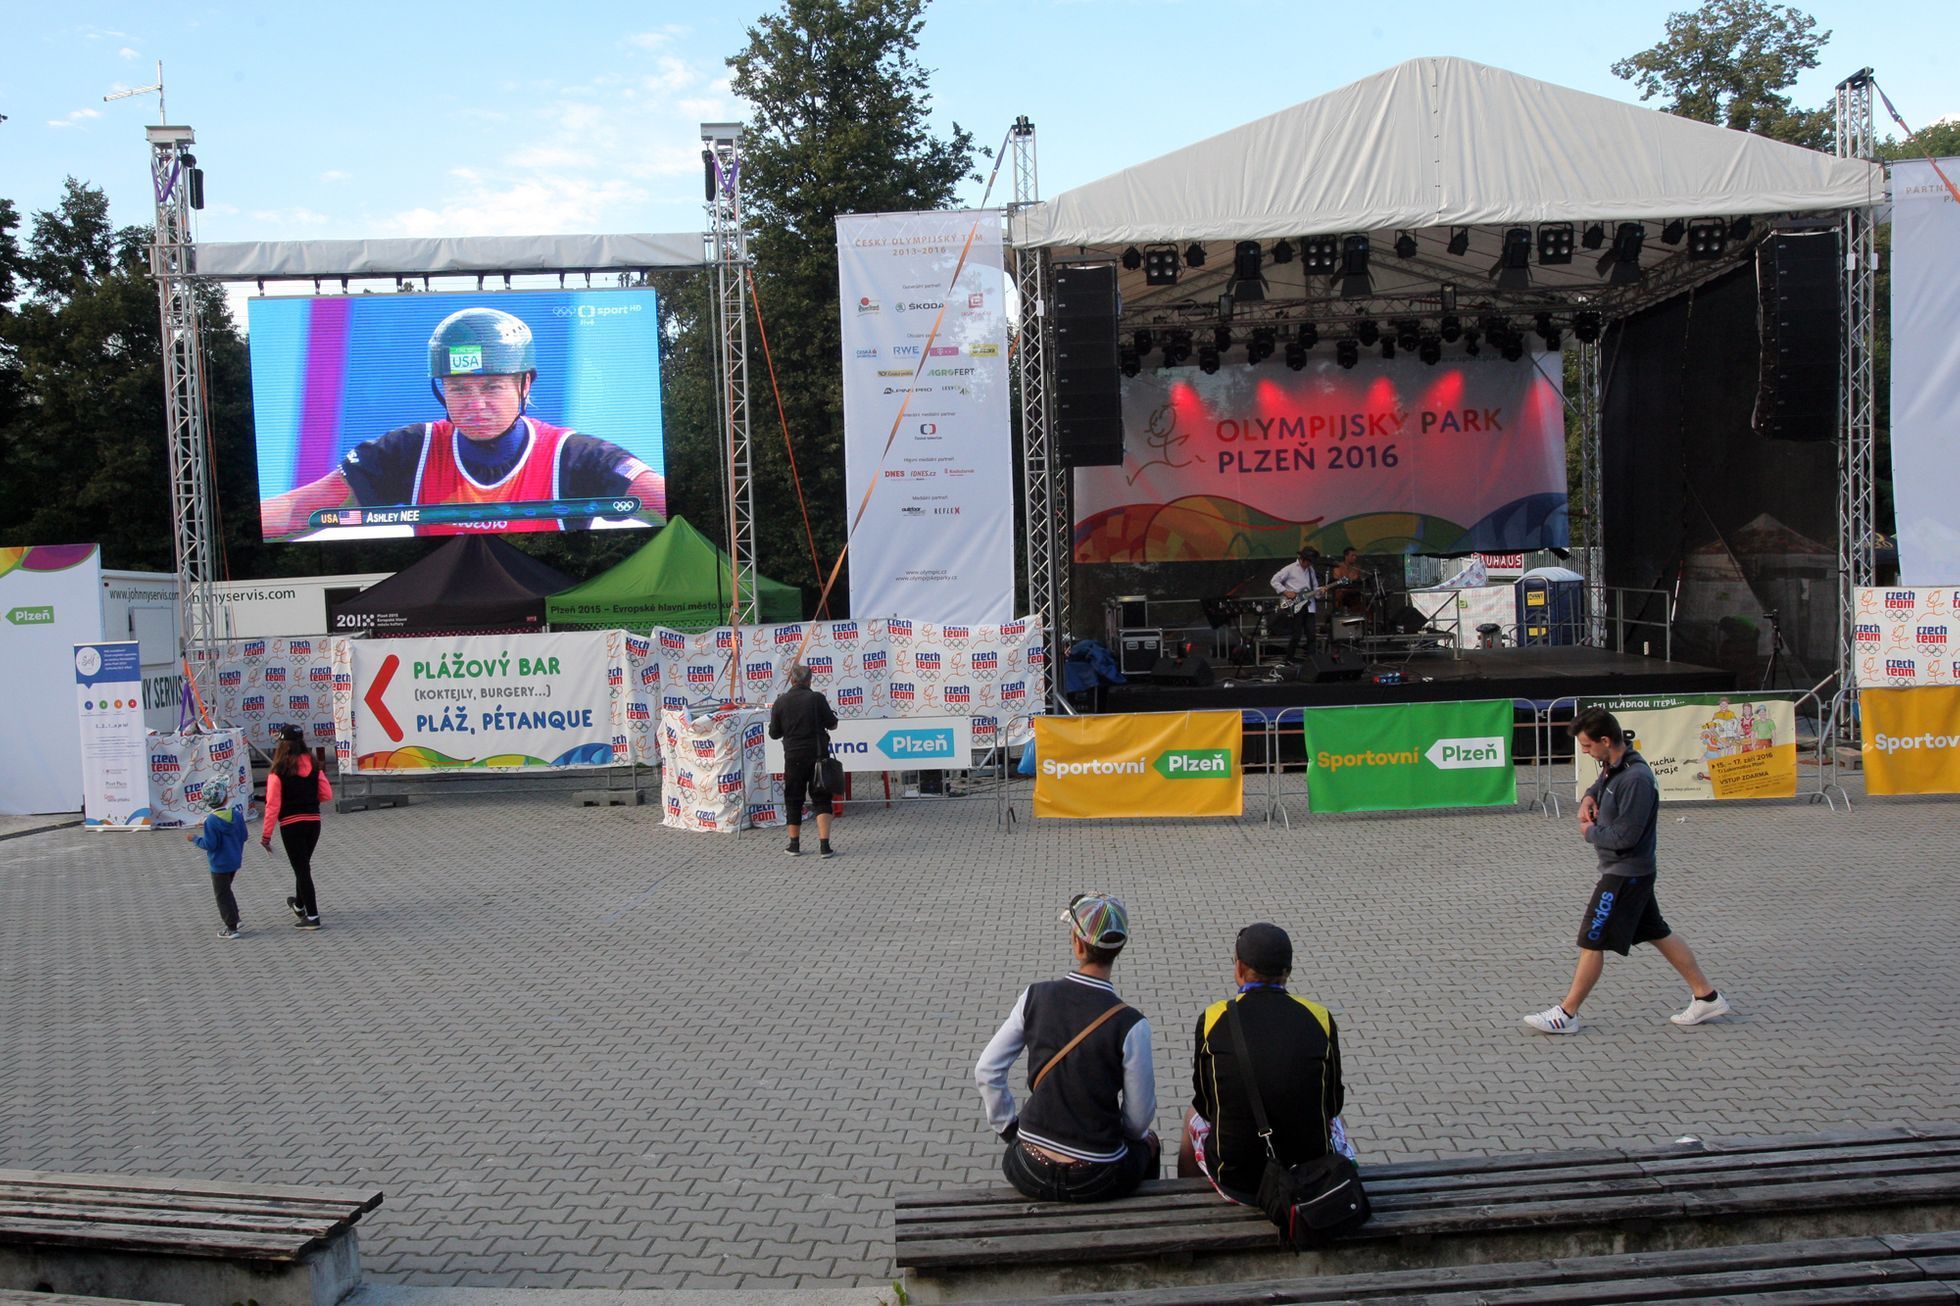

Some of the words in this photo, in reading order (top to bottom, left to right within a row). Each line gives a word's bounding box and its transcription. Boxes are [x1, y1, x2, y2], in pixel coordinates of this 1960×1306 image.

[855, 238, 887, 247] ČESKÝ
[892, 234, 957, 246] OLYMPIJSKÝ
[962, 234, 983, 242] TM
[597, 306, 629, 316] sport
[629, 304, 642, 312] HD
[908, 302, 944, 310] ŠKODA
[893, 345, 920, 355] RWE
[452, 355, 479, 368] USA
[927, 368, 975, 377] AGROFERT
[1421, 408, 1503, 434] PARK
[1218, 441, 1316, 474] PLZEŇ
[1328, 445, 1399, 469] 2016
[320, 514, 339, 524] USA
[400, 510, 420, 522] NEE
[1886, 590, 1915, 600] czech
[550, 605, 576, 615] Plzeň
[578, 604, 601, 614] 2015
[613, 603, 655, 614] Evropské
[657, 602, 686, 612] hlavní
[688, 600, 717, 610] město
[1885, 600, 1914, 608] team
[15, 610, 50, 621] Plzeň
[832, 621, 858, 632] czech
[887, 619, 912, 628] czech
[717, 630, 742, 640] czeh
[774, 624, 802, 637] czech
[832, 630, 858, 640] team
[887, 626, 912, 636] team
[943, 630, 969, 638] team
[1000, 625, 1025, 635] team
[1917, 625, 1947, 635] czech
[660, 630, 685, 642] czech
[774, 633, 803, 644] team
[1916, 634, 1946, 643] team
[244, 640, 265, 650] czech
[289, 640, 310, 649] czech
[660, 639, 685, 649] team
[244, 647, 265, 657] team
[289, 647, 311, 655] team
[863, 650, 886, 661] czech
[972, 651, 997, 661] czech
[807, 656, 832, 665] czech
[915, 652, 940, 661] czech
[413, 650, 510, 680] PLÁŽOVÝ
[519, 656, 561, 676] BAR
[746, 661, 772, 672] czech
[863, 660, 887, 670] team
[916, 661, 941, 670] team
[972, 660, 998, 669] team
[1886, 659, 1915, 668] czech
[265, 666, 286, 675] czech
[310, 666, 332, 675] czech
[687, 664, 714, 674] czech
[1886, 667, 1915, 677] team
[219, 670, 241, 679] czech
[265, 674, 286, 682] team
[310, 673, 332, 681] team
[687, 674, 714, 682] team
[746, 670, 772, 680] team
[219, 678, 241, 686] team
[332, 682, 351, 691] eam
[890, 682, 914, 692] czech
[1001, 680, 1025, 691] czech
[153, 675, 184, 708] SERVIS
[414, 688, 477, 701] (KOKTEJLY,
[480, 684, 551, 698] BURGERY...)
[837, 686, 863, 697] czech
[944, 685, 970, 694] czech
[243, 695, 264, 704] czech
[289, 695, 309, 704] czech
[890, 690, 915, 700] team
[944, 693, 970, 702] team
[1001, 690, 1025, 700] team
[289, 702, 309, 710] team
[663, 696, 688, 706] czech
[837, 696, 863, 706] team
[242, 702, 264, 711] team
[416, 705, 476, 735] PLÁŽ,
[482, 704, 593, 731] PÉTANQUE
[626, 711, 650, 719] team
[313, 721, 335, 731] czech
[972, 716, 998, 726] czech
[314, 728, 336, 737] team
[209, 739, 233, 753] czech
[692, 739, 714, 749] czech
[892, 734, 948, 753] Plzeň
[1875, 733, 1960, 755] Sportov
[210, 748, 235, 762] team
[695, 748, 715, 758] team
[1317, 746, 1419, 773] Sportovní
[1442, 743, 1498, 762] Plzeň
[1756, 752, 1774, 761] 2016
[152, 754, 178, 764] czech
[1649, 756, 1676, 767] ruchu
[152, 763, 180, 772] team
[1042, 756, 1146, 780] Sportovní
[1168, 754, 1225, 772] Plzeň
[1654, 766, 1678, 776] kraje
[1719, 776, 1741, 785] VSTUP
[1742, 771, 1769, 781] ZDARMA
[695, 809, 715, 820] czech
[1587, 891, 1614, 940] adidas
